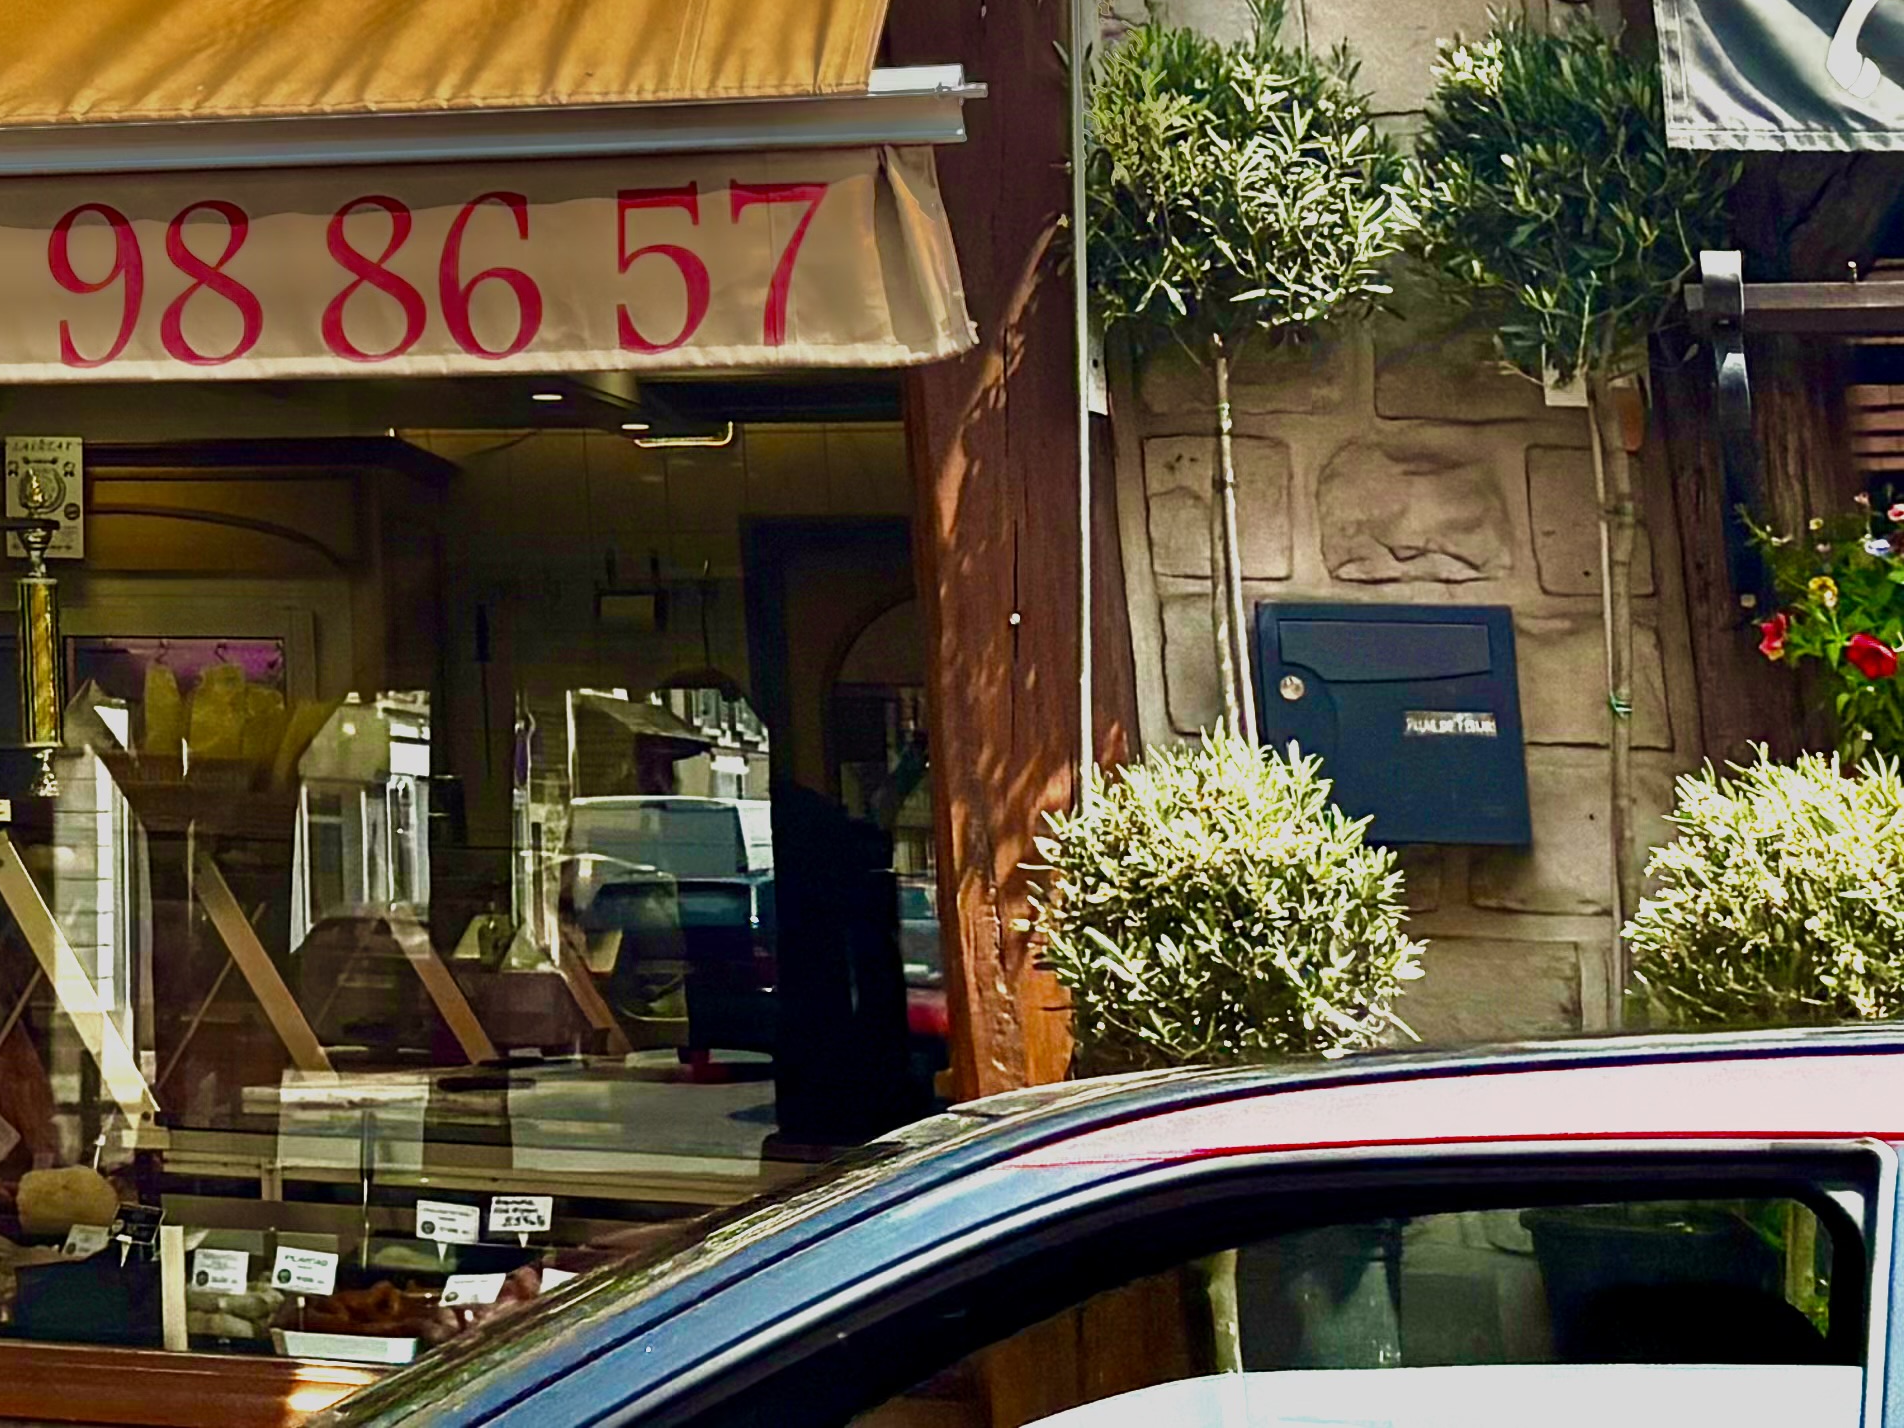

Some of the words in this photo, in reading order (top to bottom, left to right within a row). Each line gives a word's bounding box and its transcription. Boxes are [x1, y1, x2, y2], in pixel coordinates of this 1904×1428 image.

[47, 199, 264, 369] 98
[321, 190, 543, 363] 86
[616, 178, 829, 354] 57
